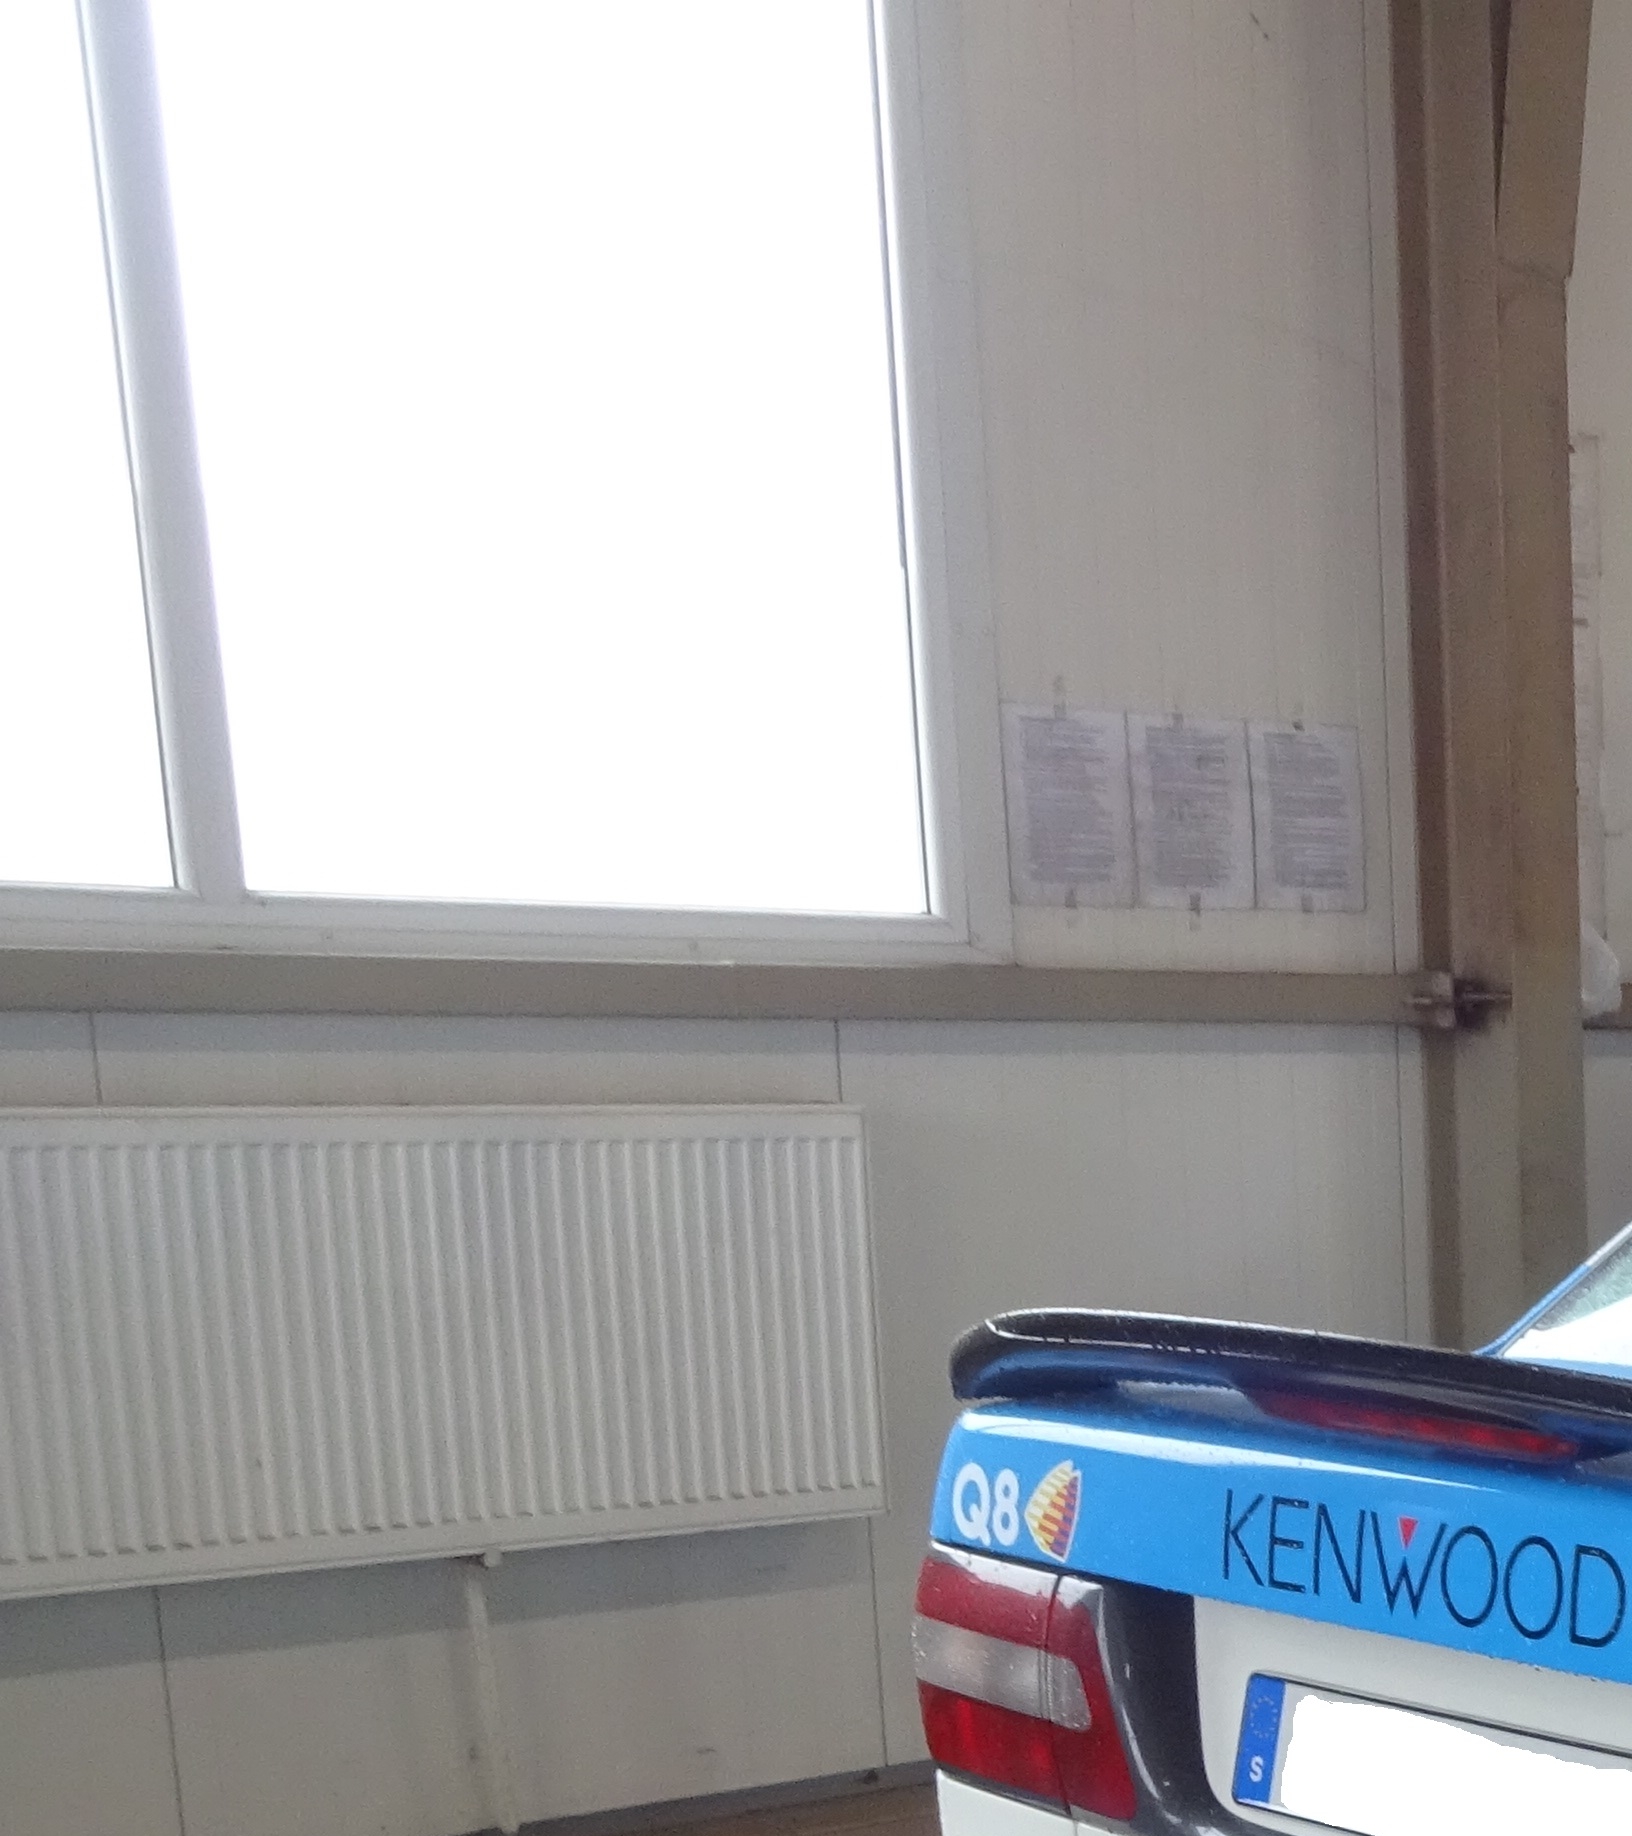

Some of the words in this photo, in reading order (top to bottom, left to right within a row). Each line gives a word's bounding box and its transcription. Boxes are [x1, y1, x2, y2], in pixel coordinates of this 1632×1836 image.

[952, 1462, 1020, 1547] Q8
[1221, 1487, 1627, 1648] KENWOOD
[1248, 1755, 1264, 1783] S
